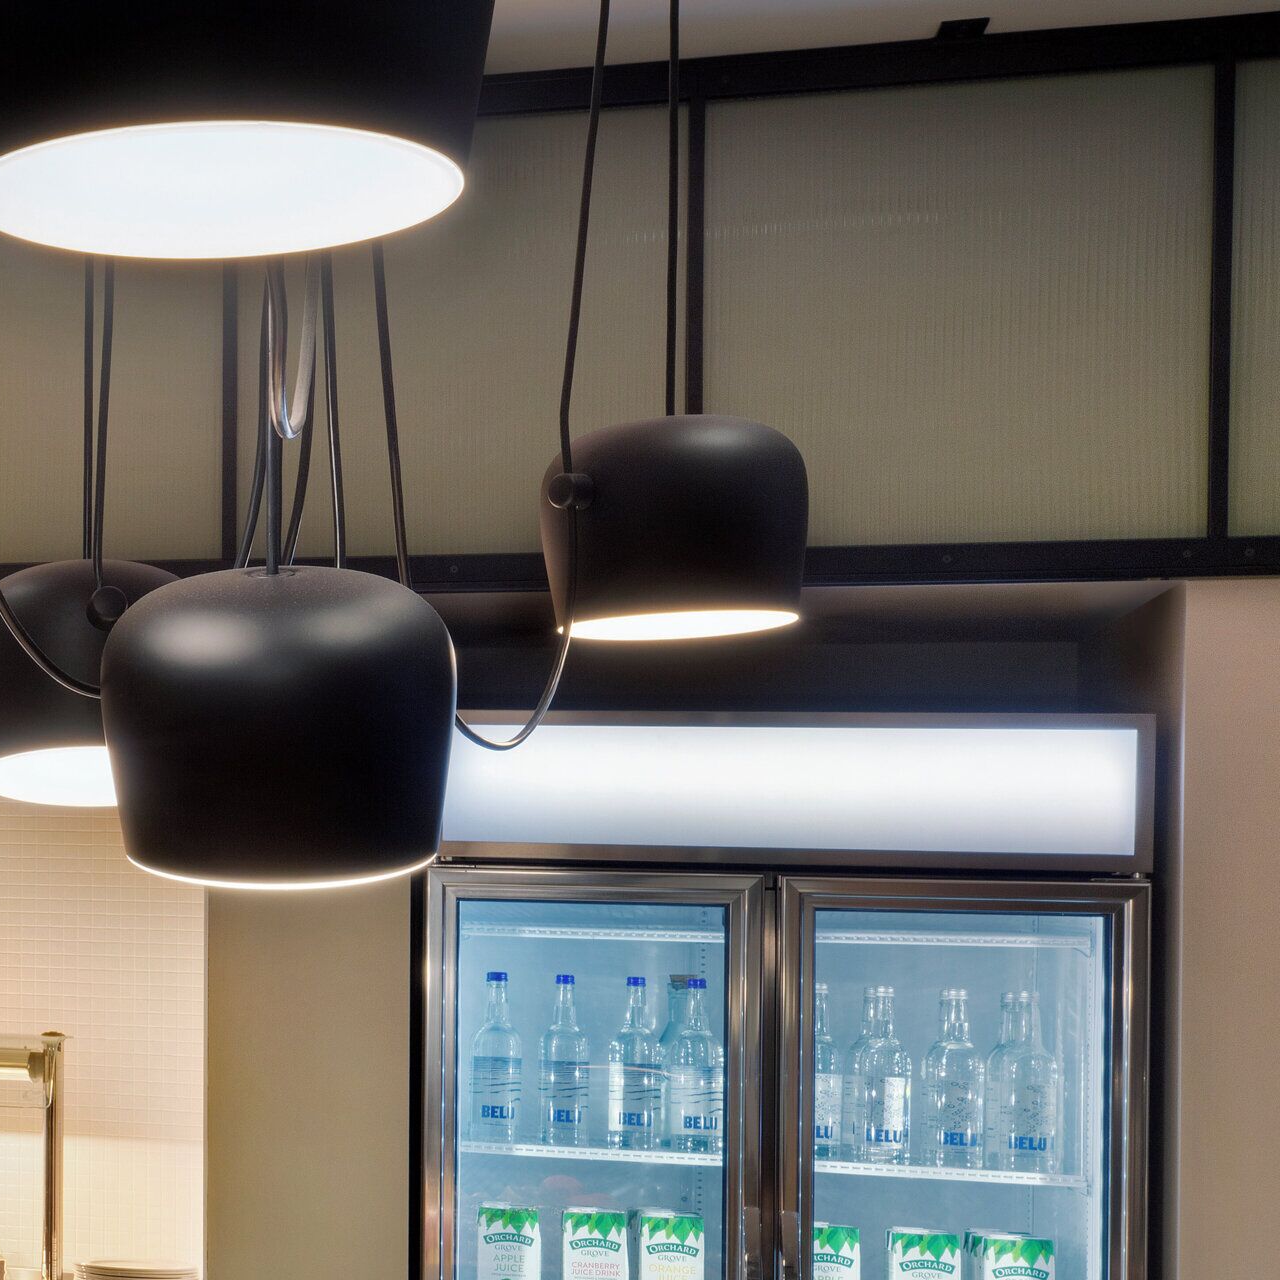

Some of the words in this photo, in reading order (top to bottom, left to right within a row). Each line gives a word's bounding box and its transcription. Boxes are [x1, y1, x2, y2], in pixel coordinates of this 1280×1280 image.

[481, 1105, 515, 1120] BELU
[548, 1109, 582, 1124] BELU
[619, 1111, 652, 1127] BELU
[683, 1115, 718, 1130] BELU
[816, 1125, 833, 1140] LU
[866, 1128, 904, 1143] BELU
[941, 1131, 977, 1147] BELU
[1008, 1136, 1047, 1151] BELU
[486, 1233, 532, 1245] ORCHARD
[572, 1239, 619, 1250] ORCHARD
[494, 1244, 523, 1252] GROVE
[580, 1249, 610, 1257] GROVE
[649, 1244, 696, 1255] ORCHARD
[493, 1254, 526, 1263] APPLE
[495, 1264, 525, 1272] JUICE
[571, 1261, 620, 1270] CRANBERRY
[648, 1264, 697, 1275] ORANGE
[903, 1261, 952, 1273] ORCHARD
[912, 1271, 941, 1279] GROVE
[995, 1267, 1046, 1278] ORCHARD
